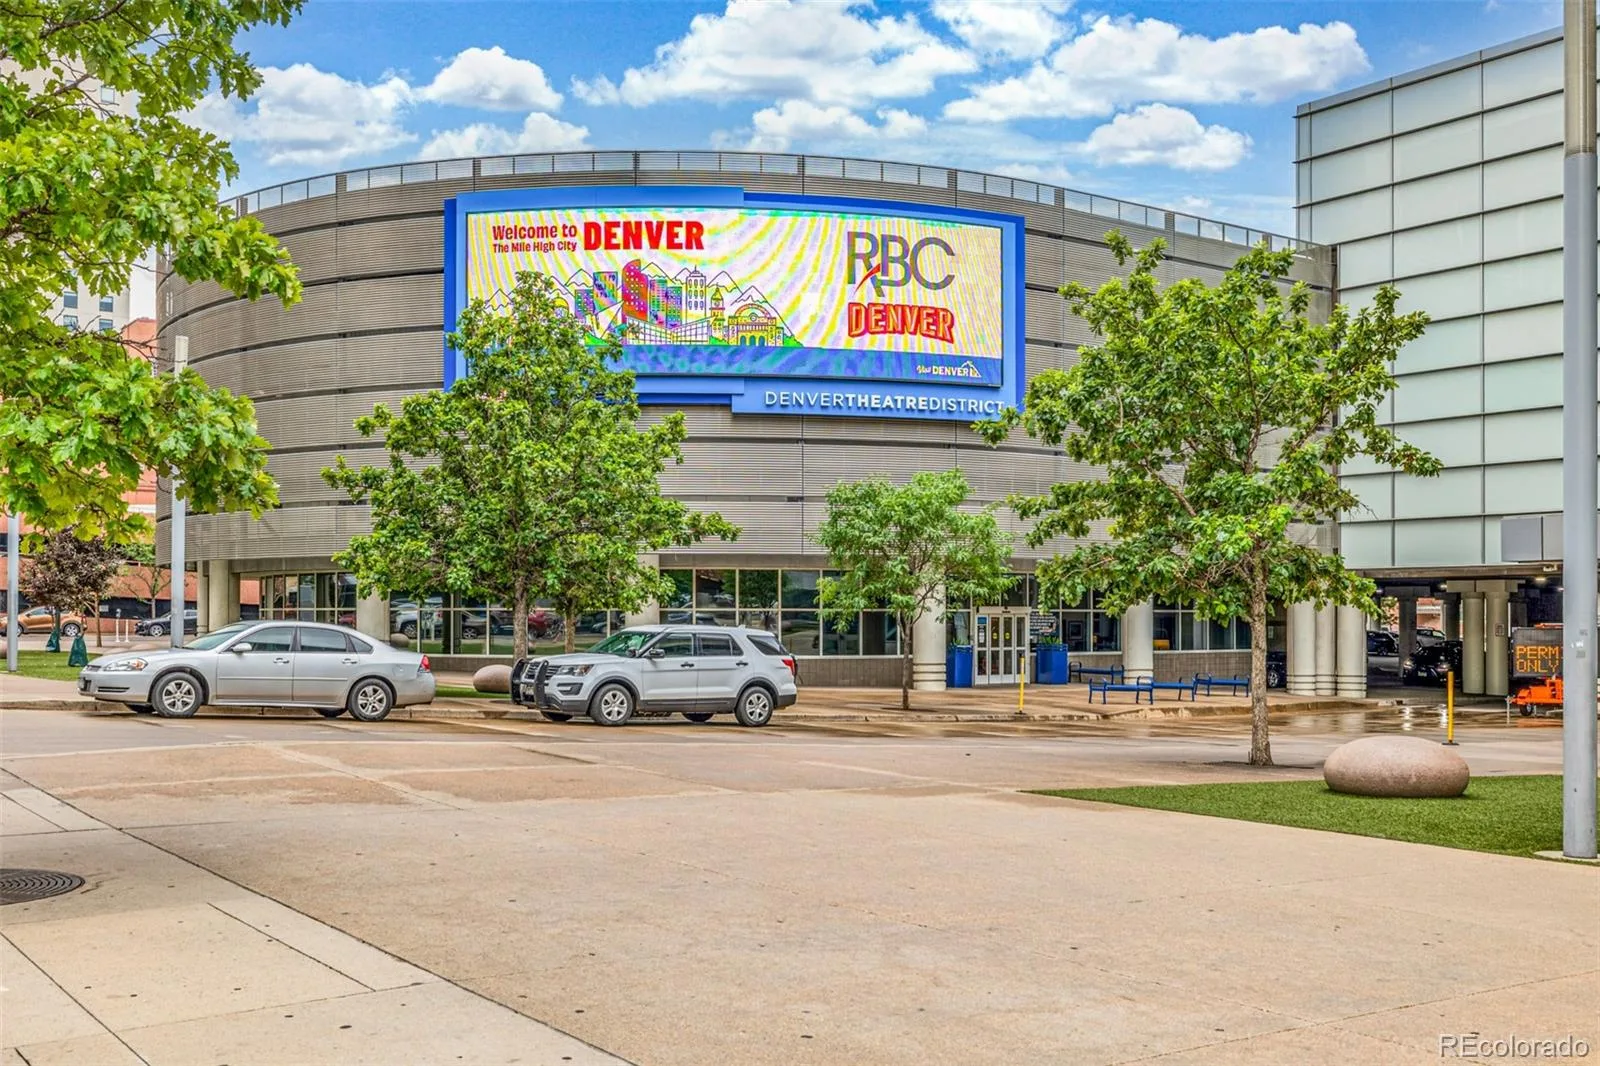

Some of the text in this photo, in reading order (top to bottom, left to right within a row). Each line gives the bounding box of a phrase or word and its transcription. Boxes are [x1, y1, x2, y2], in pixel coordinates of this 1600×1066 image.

[492, 221, 704, 251] Welcome to DENVER
[492, 240, 577, 254] The Mile High City
[847, 231, 955, 297] RBC
[848, 302, 955, 344] DENVER
[932, 366, 969, 377] DENVER
[1516, 645, 1563, 659] PERM
[1516, 660, 1559, 673] ONLY
